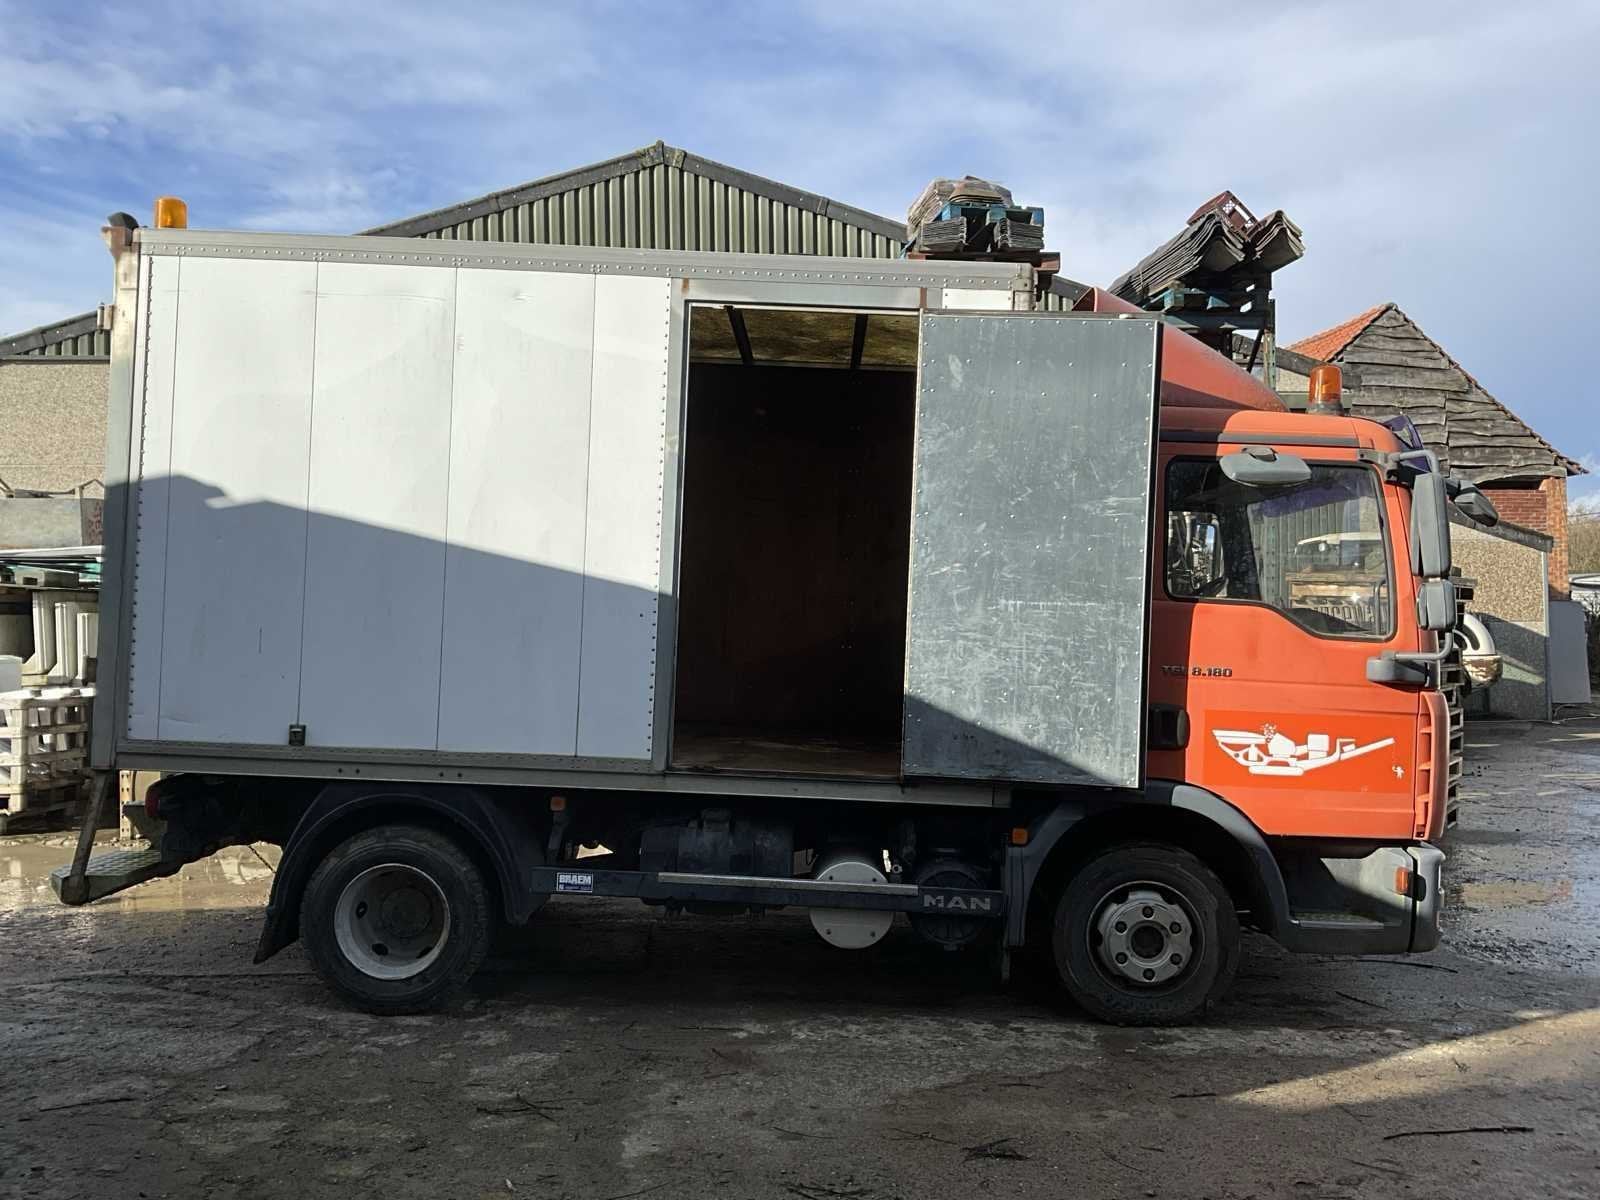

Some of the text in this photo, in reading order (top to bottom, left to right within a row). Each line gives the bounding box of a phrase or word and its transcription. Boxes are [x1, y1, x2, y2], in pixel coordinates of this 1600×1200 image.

[1191, 666, 1232, 677] 8.180
[559, 874, 591, 884] BRAEM
[924, 894, 991, 910] MAN
